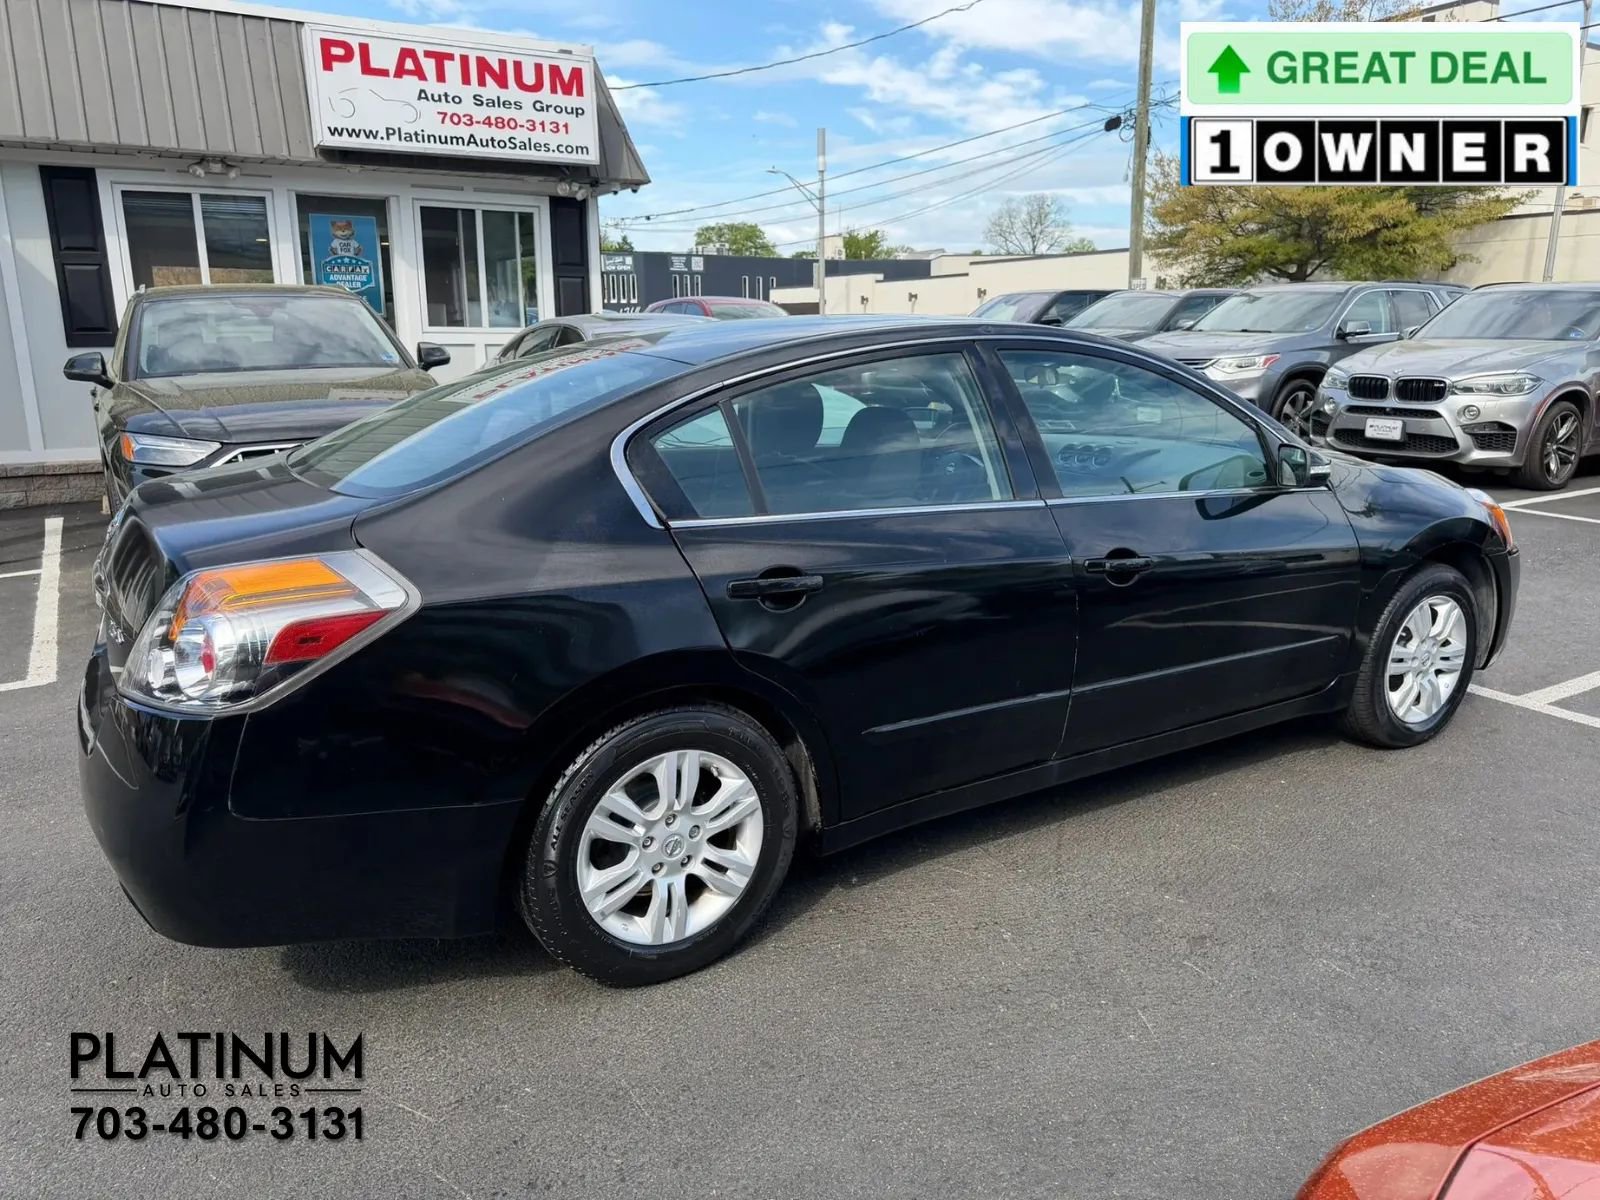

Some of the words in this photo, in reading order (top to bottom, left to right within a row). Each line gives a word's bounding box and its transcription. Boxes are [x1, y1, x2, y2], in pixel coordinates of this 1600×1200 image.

[319, 37, 585, 97] PLATINUM
[417, 88, 463, 105] Auto
[473, 93, 523, 111] Sales
[532, 99, 585, 118] Group
[436, 111, 570, 135] 703-480-3131
[328, 125, 589, 156] www.PlatinumAutoSales.com
[326, 265, 369, 273] CARFAX
[330, 274, 368, 282] ADVANTAGE
